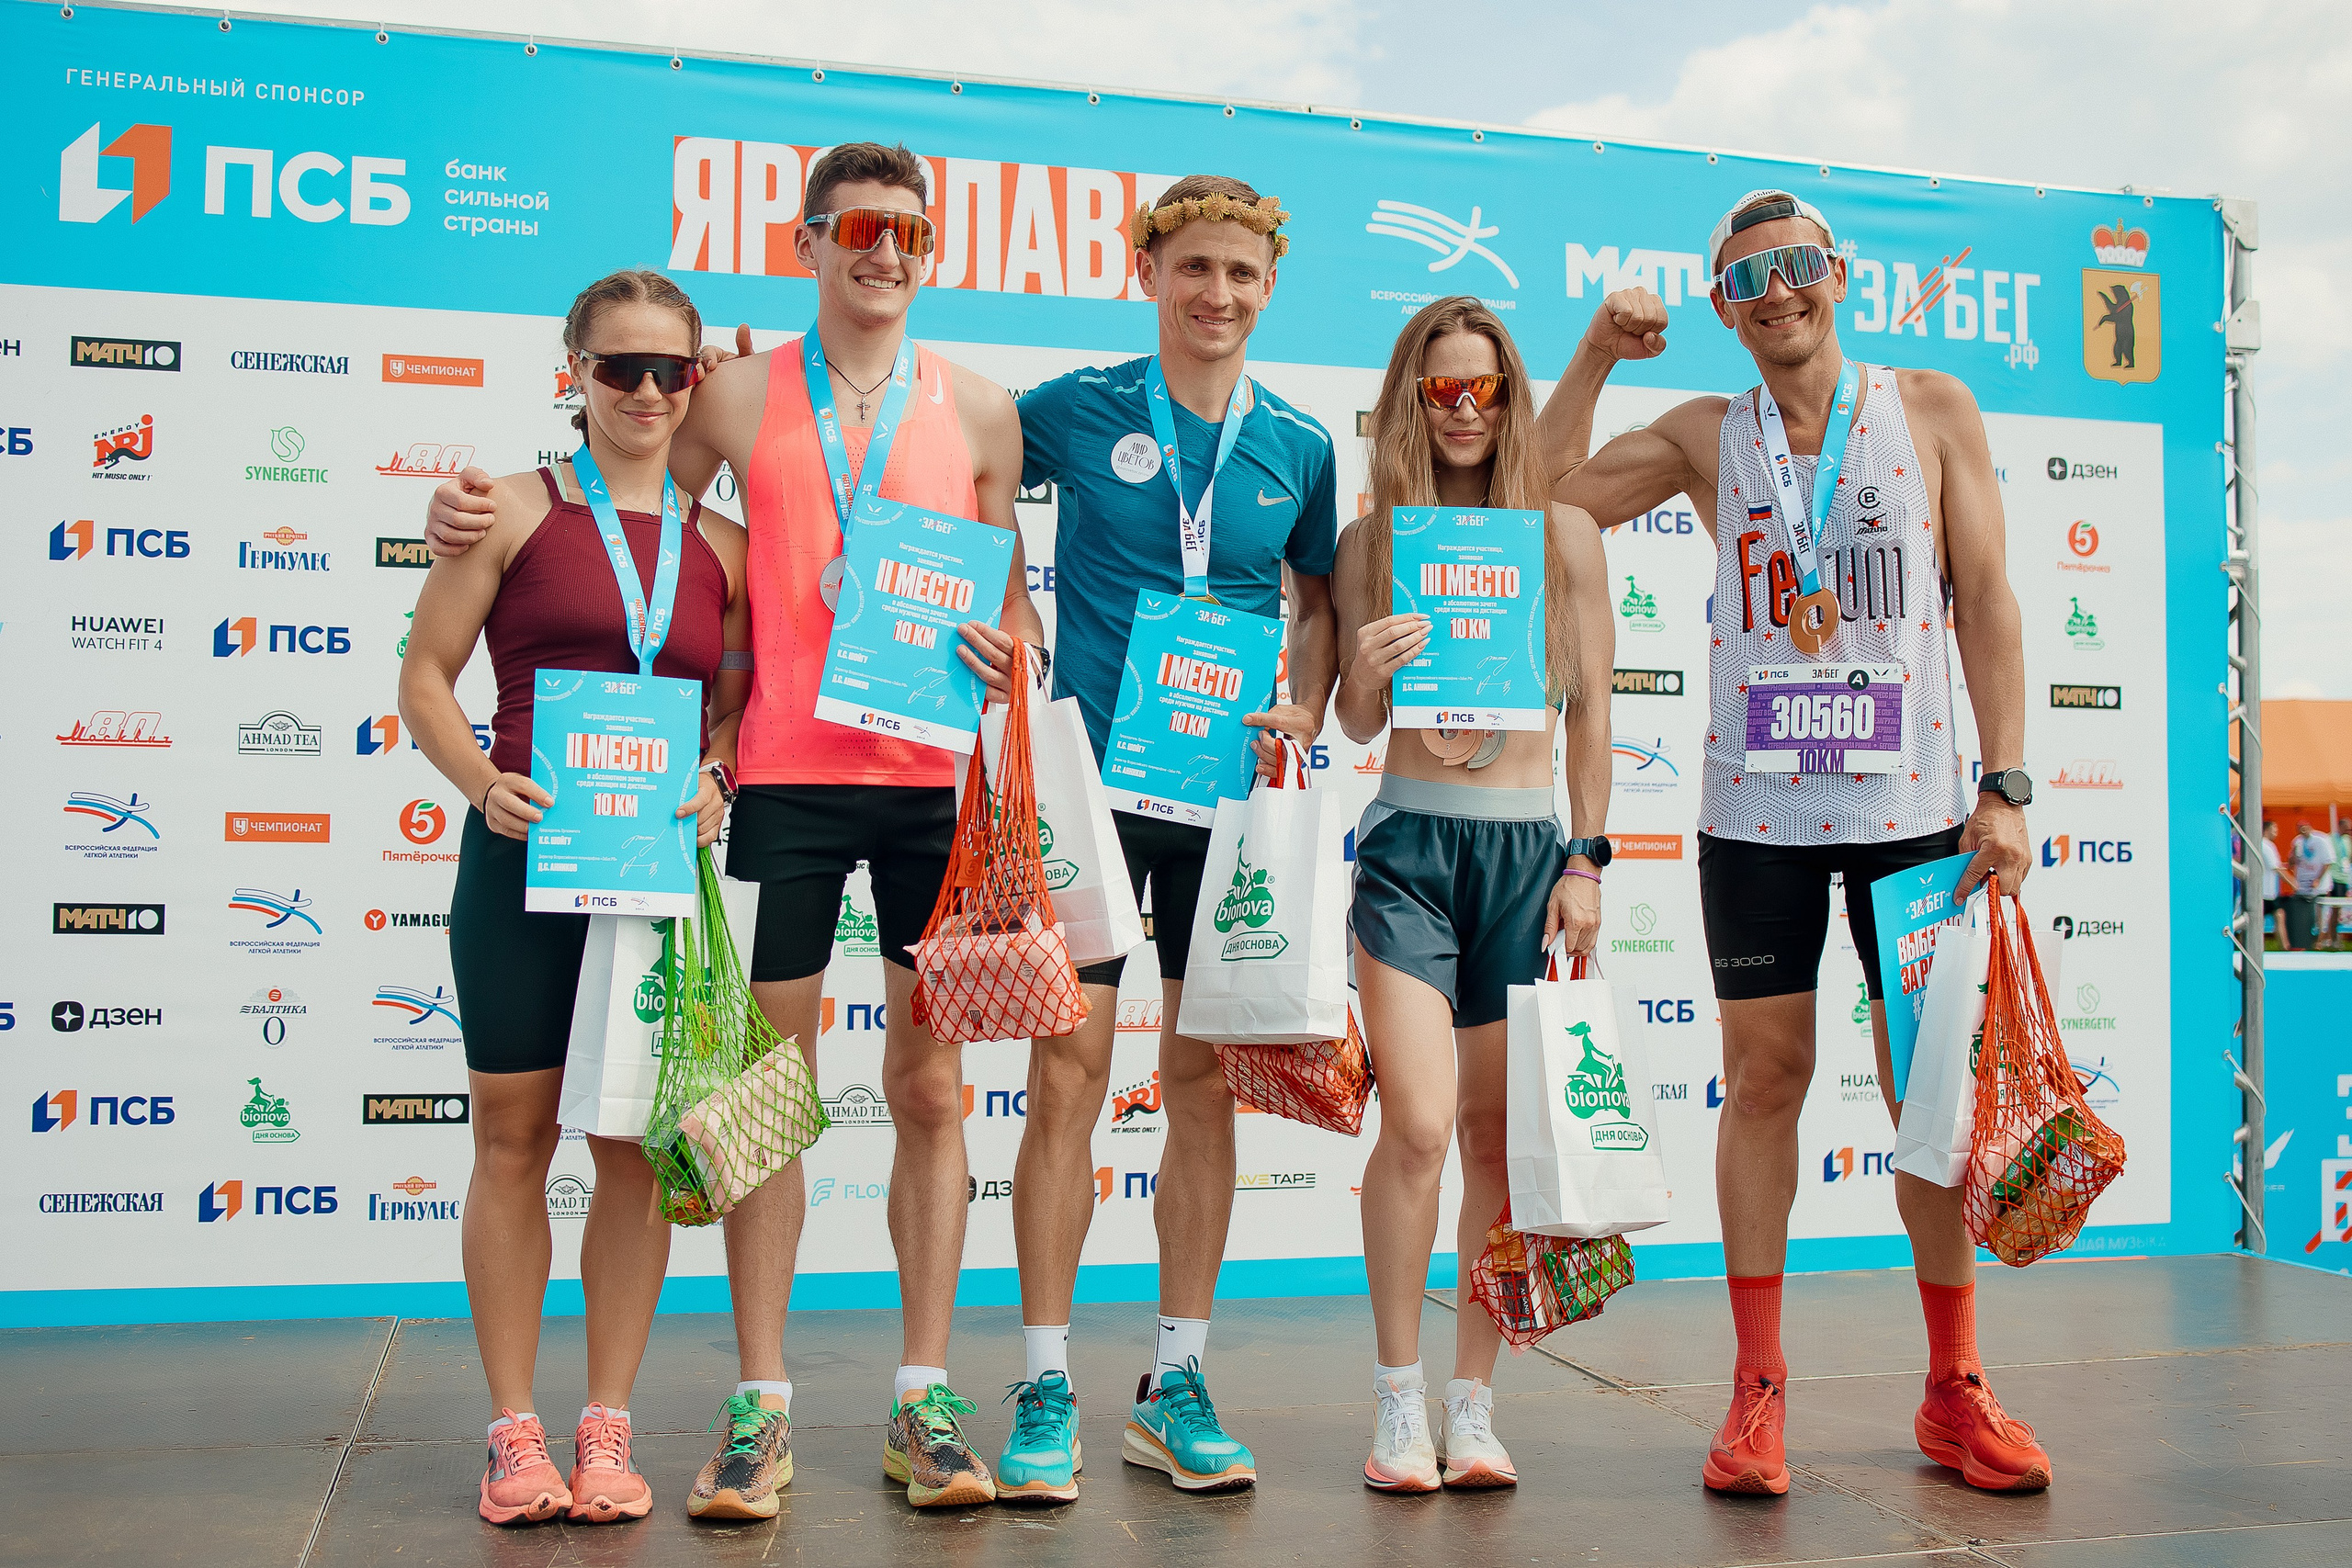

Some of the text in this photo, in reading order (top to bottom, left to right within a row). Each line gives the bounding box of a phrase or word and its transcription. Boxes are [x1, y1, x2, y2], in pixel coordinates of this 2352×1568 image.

[66, 68, 365, 107] ГЕНЕРАЛЬНЫЙ СПОНСОР
[445, 159, 507, 182] банк
[204, 145, 411, 226] ПСБ
[444, 188, 549, 211] сильной
[444, 215, 538, 237] страны
[231, 350, 350, 375] СЕНЕЖСКАЯ
[406, 364, 477, 378] ЧЕМПИОНАТ
[898, 357, 910, 376] ПСБ
[1840, 382, 1853, 402] ПСБ
[94, 423, 140, 439] ENERGY
[823, 421, 837, 444] ПСБ
[1117, 450, 1155, 470] ЦВЕТОВ
[92, 472, 103, 480] HIT
[245, 466, 328, 483] SYNERGETIC
[1780, 466, 1792, 488] ПСБ
[2071, 463, 2118, 479] дзен
[107, 527, 191, 558] ПСБ
[1437, 544, 1476, 553] Награждается
[239, 541, 331, 572] ГЕРКУЛЕС
[613, 546, 628, 569] ПСБ
[875, 558, 976, 614] II МЕСТО
[1420, 563, 1521, 599] III МЕСТО
[1620, 602, 1657, 615] bionova
[71, 615, 164, 634] HUAWEI
[650, 607, 666, 632] ПСБ
[1451, 618, 1491, 640] 10 КМ
[72, 637, 163, 651] WATCH FIT 4
[269, 625, 351, 654] ПСБ
[893, 620, 937, 649] 10 КМ
[1168, 655, 1244, 702] МЕСТО
[1770, 671, 1789, 679] ПСБ
[876, 716, 900, 731] ПСБ
[1170, 710, 1211, 739] 10 КМ
[1452, 713, 1475, 723] ПСБ
[1771, 694, 1875, 740] 30560
[242, 732, 319, 747] AHMAD TEA
[566, 732, 669, 773] II МЕСТО
[594, 793, 639, 818] 10 КМ
[1151, 803, 1174, 815] ПСБ
[251, 822, 322, 833] ЧЕМПИОНАТ
[64, 844, 120, 852] ВСЕРОССИЙСКАЯ
[1622, 840, 1678, 852] ЧЕМПИОНАТ
[2078, 840, 2132, 863] ПСБ
[382, 850, 460, 865] Пятёрочка
[592, 897, 617, 907] ПСБ
[1217, 899, 1272, 922] bionova
[391, 913, 450, 927] YAMAGU
[2077, 919, 2124, 937] дзен
[1226, 939, 1280, 954] ДНЯ ОСНОВА
[1611, 940, 1675, 953] SYNERGETIC
[1714, 954, 1775, 968] BG 3000
[1900, 962, 1918, 996] ЗА
[89, 1008, 162, 1029] дзен
[251, 1005, 307, 1014] БАЛТИКА
[2061, 1017, 2116, 1030] SYNERGETIC
[1112, 1079, 1151, 1097] ENERGY
[90, 1096, 175, 1125] ПСБ
[241, 1106, 290, 1123] bionova
[254, 1131, 296, 1141] ДНЯ ОСНОВА
[1595, 1130, 1645, 1142] ДНЯ ОСНОВА
[39, 1192, 164, 1213] СЕНЕЖСКАЯ
[255, 1185, 338, 1214] ПСБ
[368, 1193, 459, 1221] ГЕРКУЛЕС
